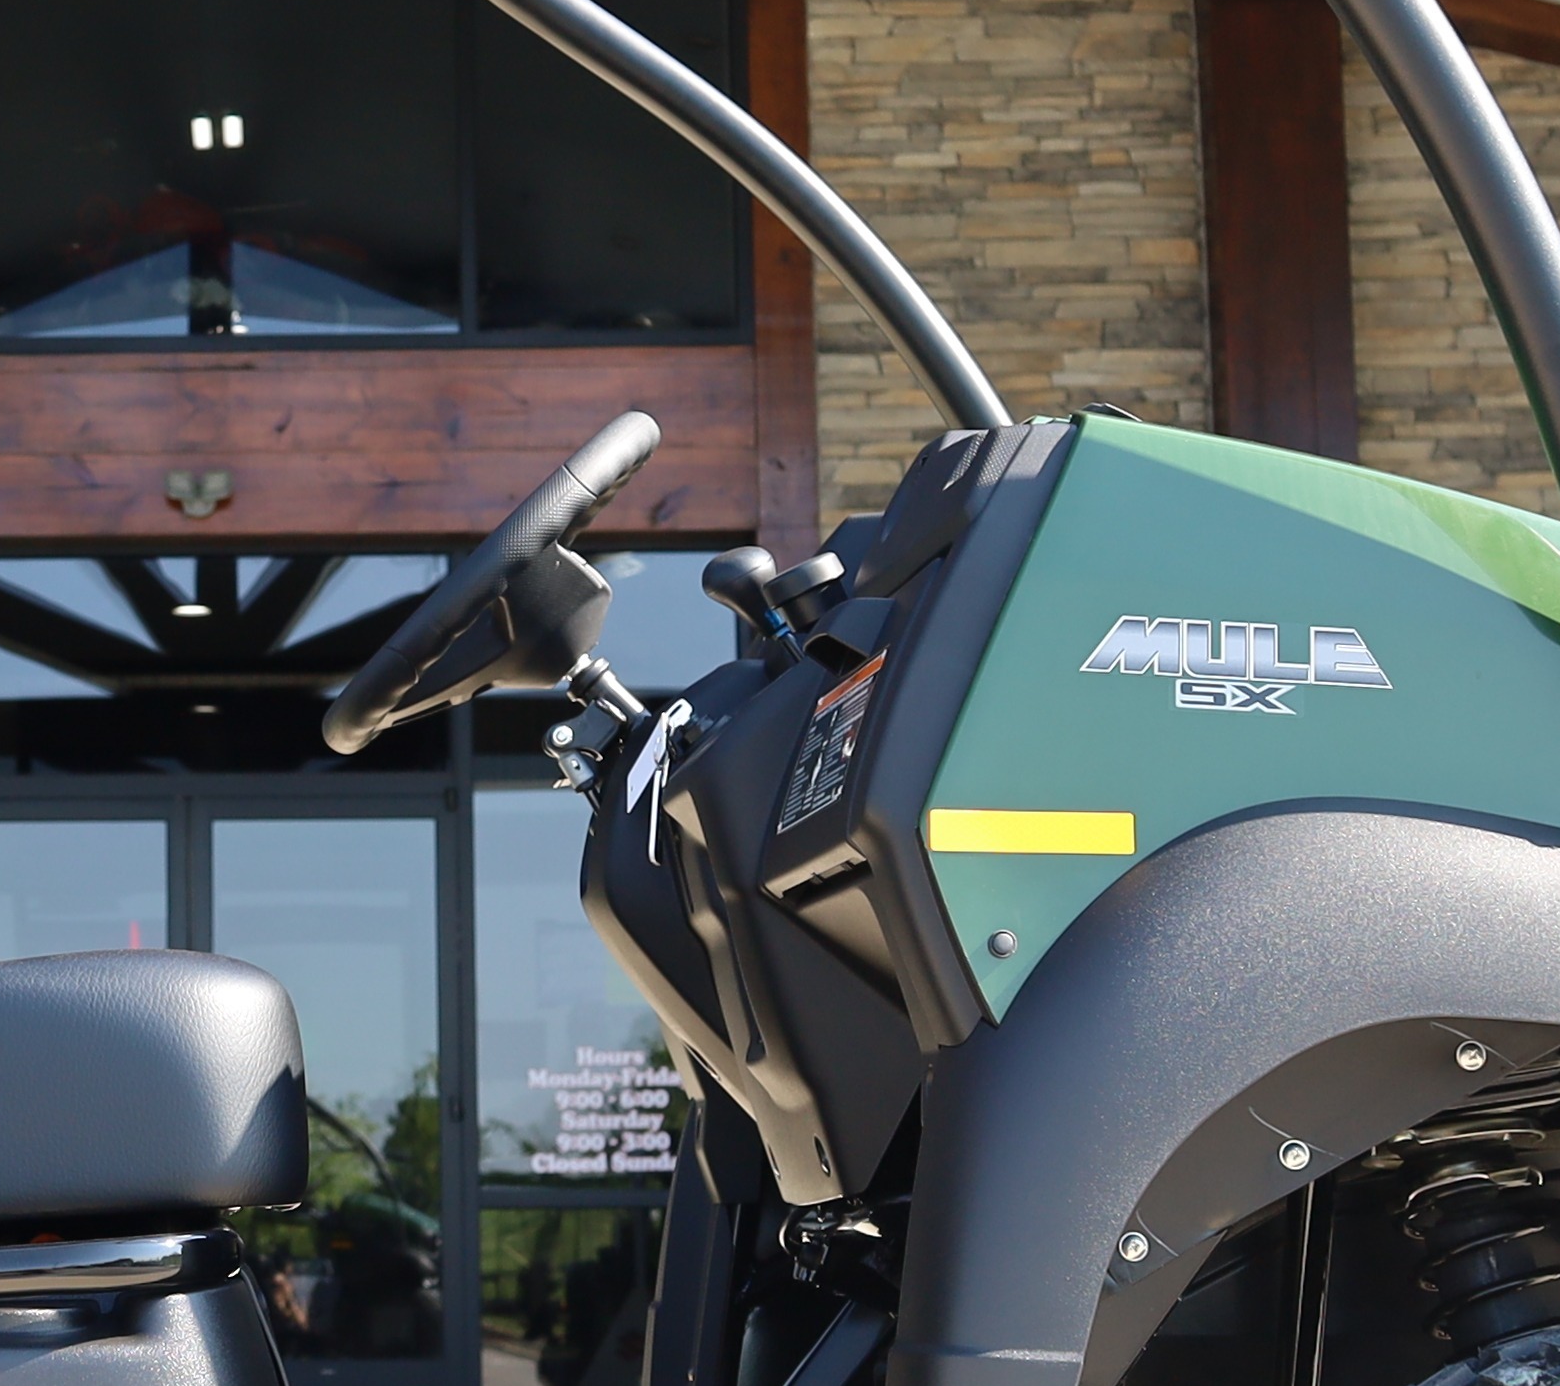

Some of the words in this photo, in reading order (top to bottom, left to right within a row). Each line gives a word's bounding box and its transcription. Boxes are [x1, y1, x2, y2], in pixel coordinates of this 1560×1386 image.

[1080, 614, 1393, 690] MULE
[1176, 679, 1297, 715] SX
[577, 1046, 646, 1066] Hours
[560, 1110, 664, 1132] Saturday
[530, 1151, 607, 1173] Closed
